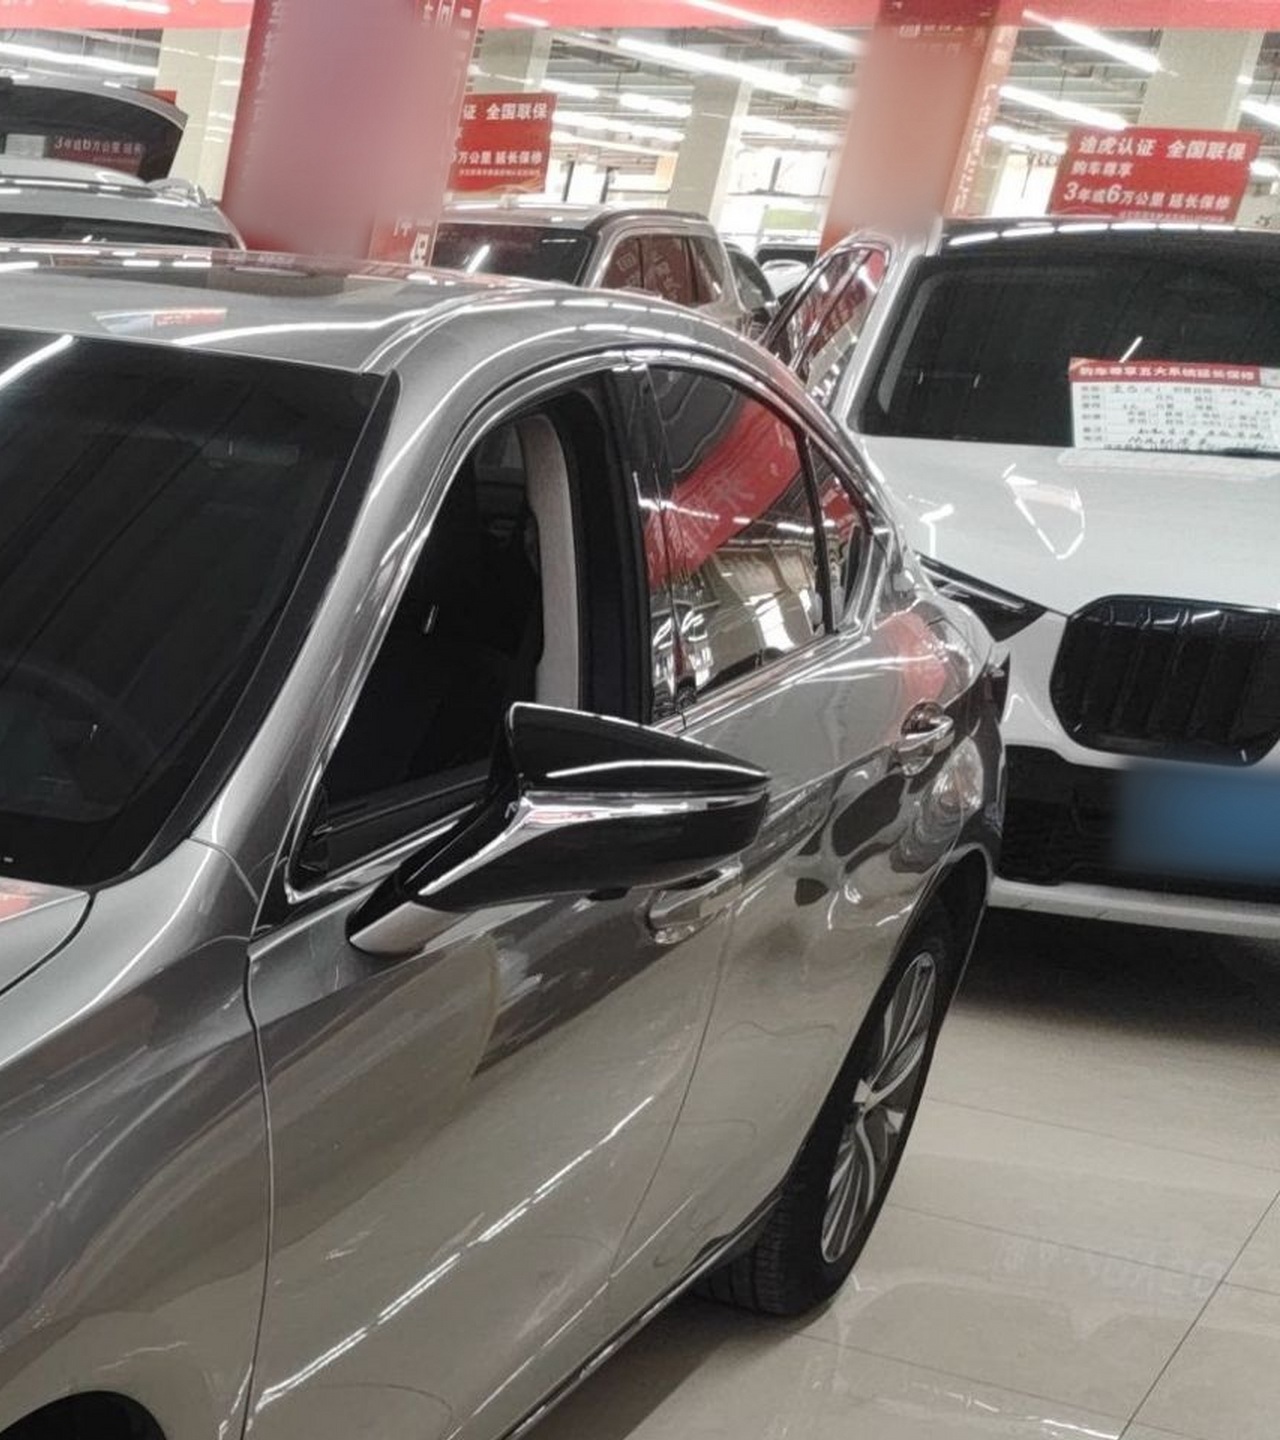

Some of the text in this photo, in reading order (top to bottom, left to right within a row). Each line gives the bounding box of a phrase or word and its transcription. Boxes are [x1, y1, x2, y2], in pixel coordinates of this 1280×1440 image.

[486, 103, 547, 120] 全国联保
[1166, 140, 1246, 161] 全国联保
